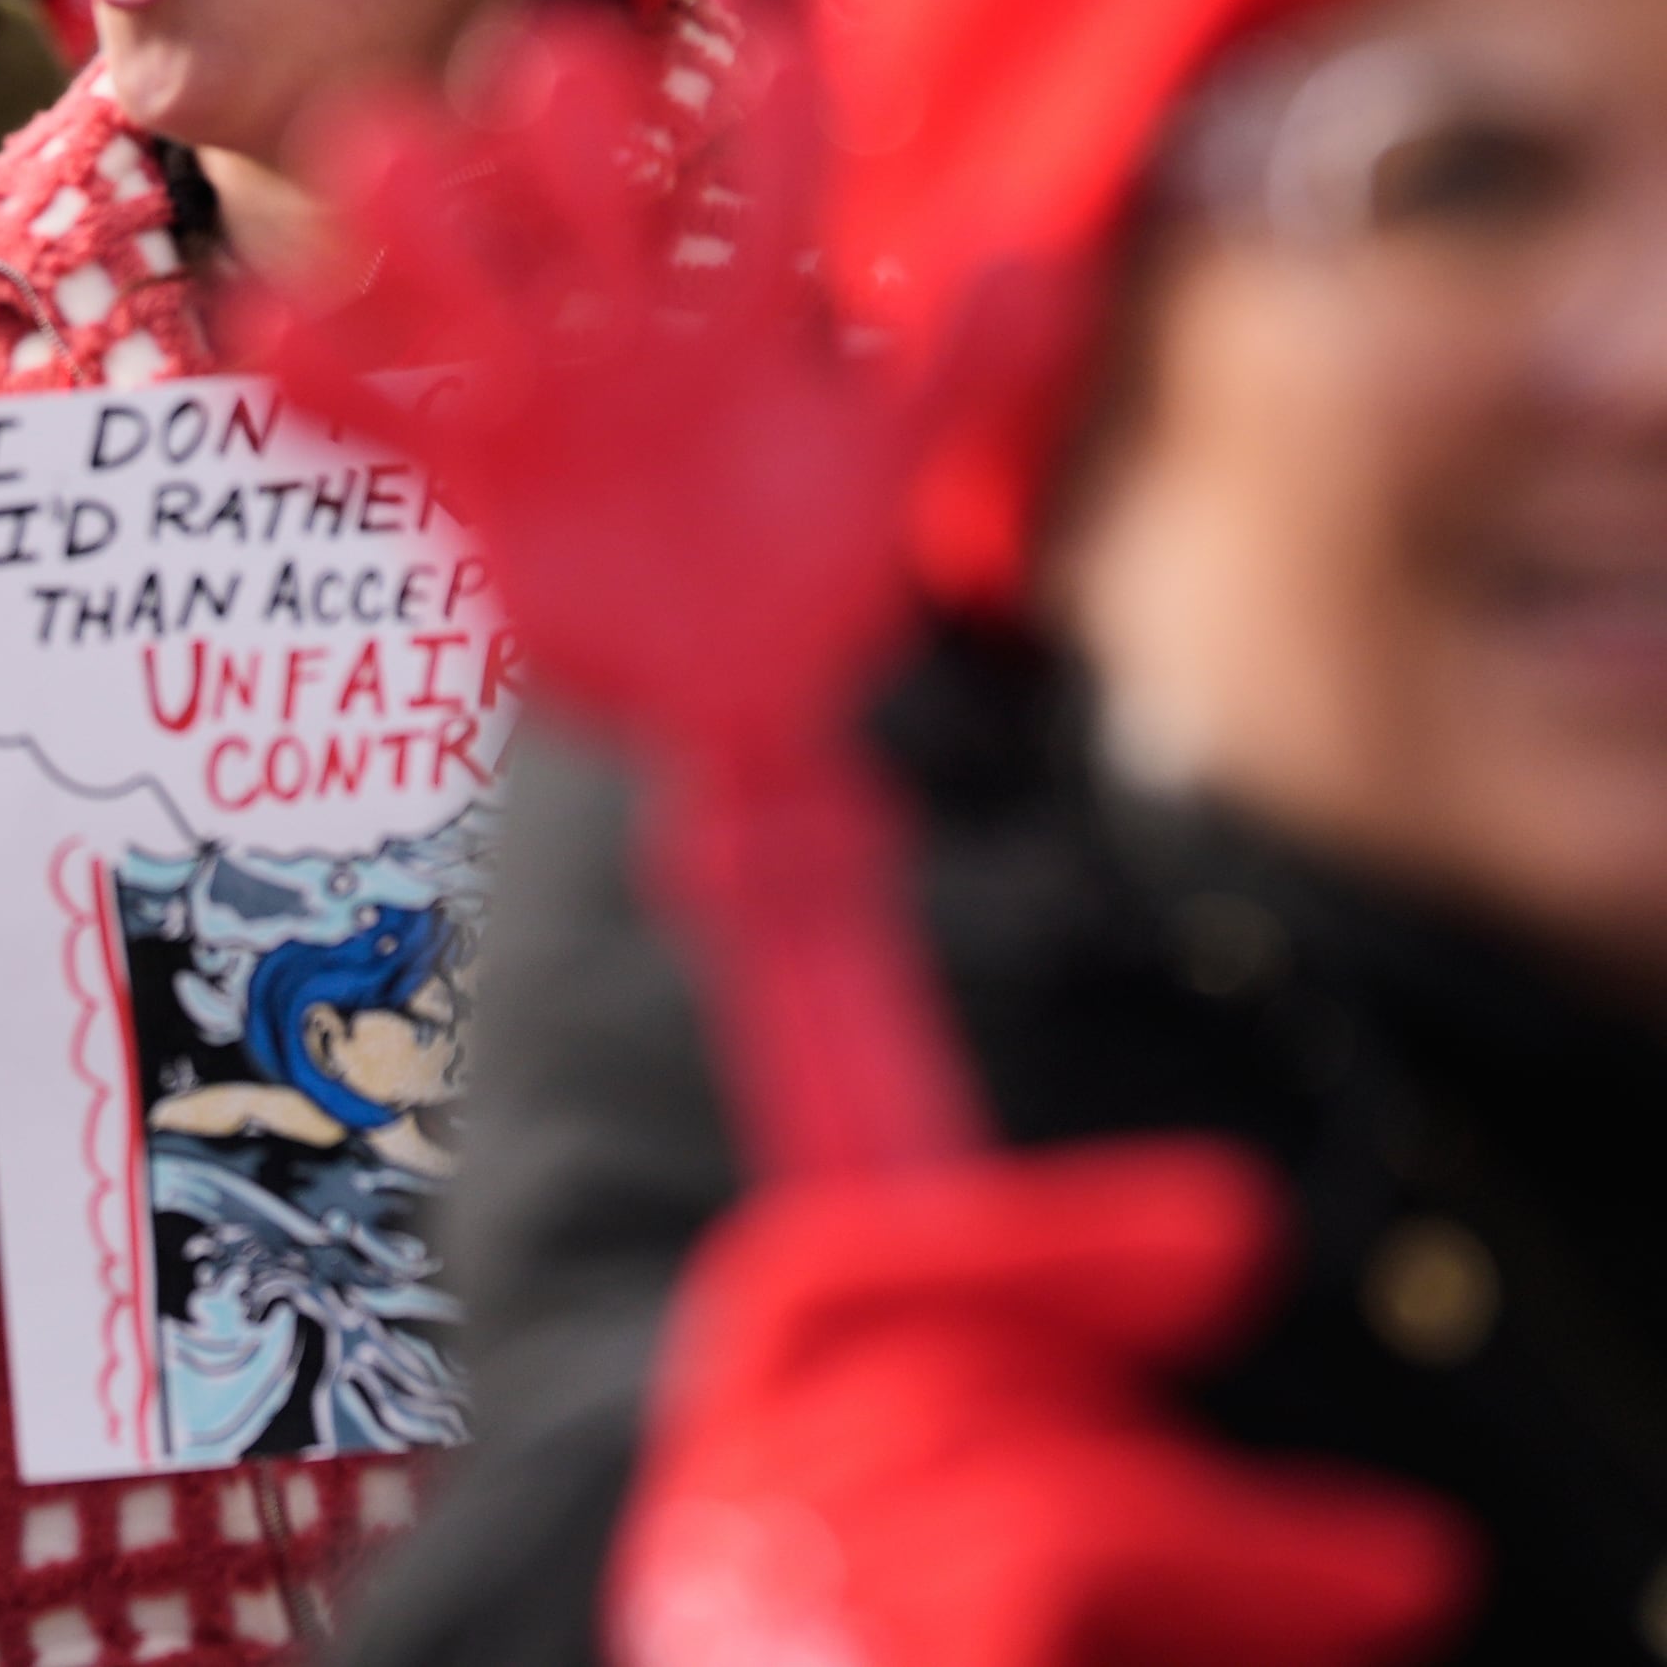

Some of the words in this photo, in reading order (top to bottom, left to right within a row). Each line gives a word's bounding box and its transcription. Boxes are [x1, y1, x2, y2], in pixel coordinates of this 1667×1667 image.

[89, 394, 307, 472] DON
[30, 570, 244, 644] THAN
[266, 558, 489, 627] ACCEP
[203, 716, 499, 813] CONTR
